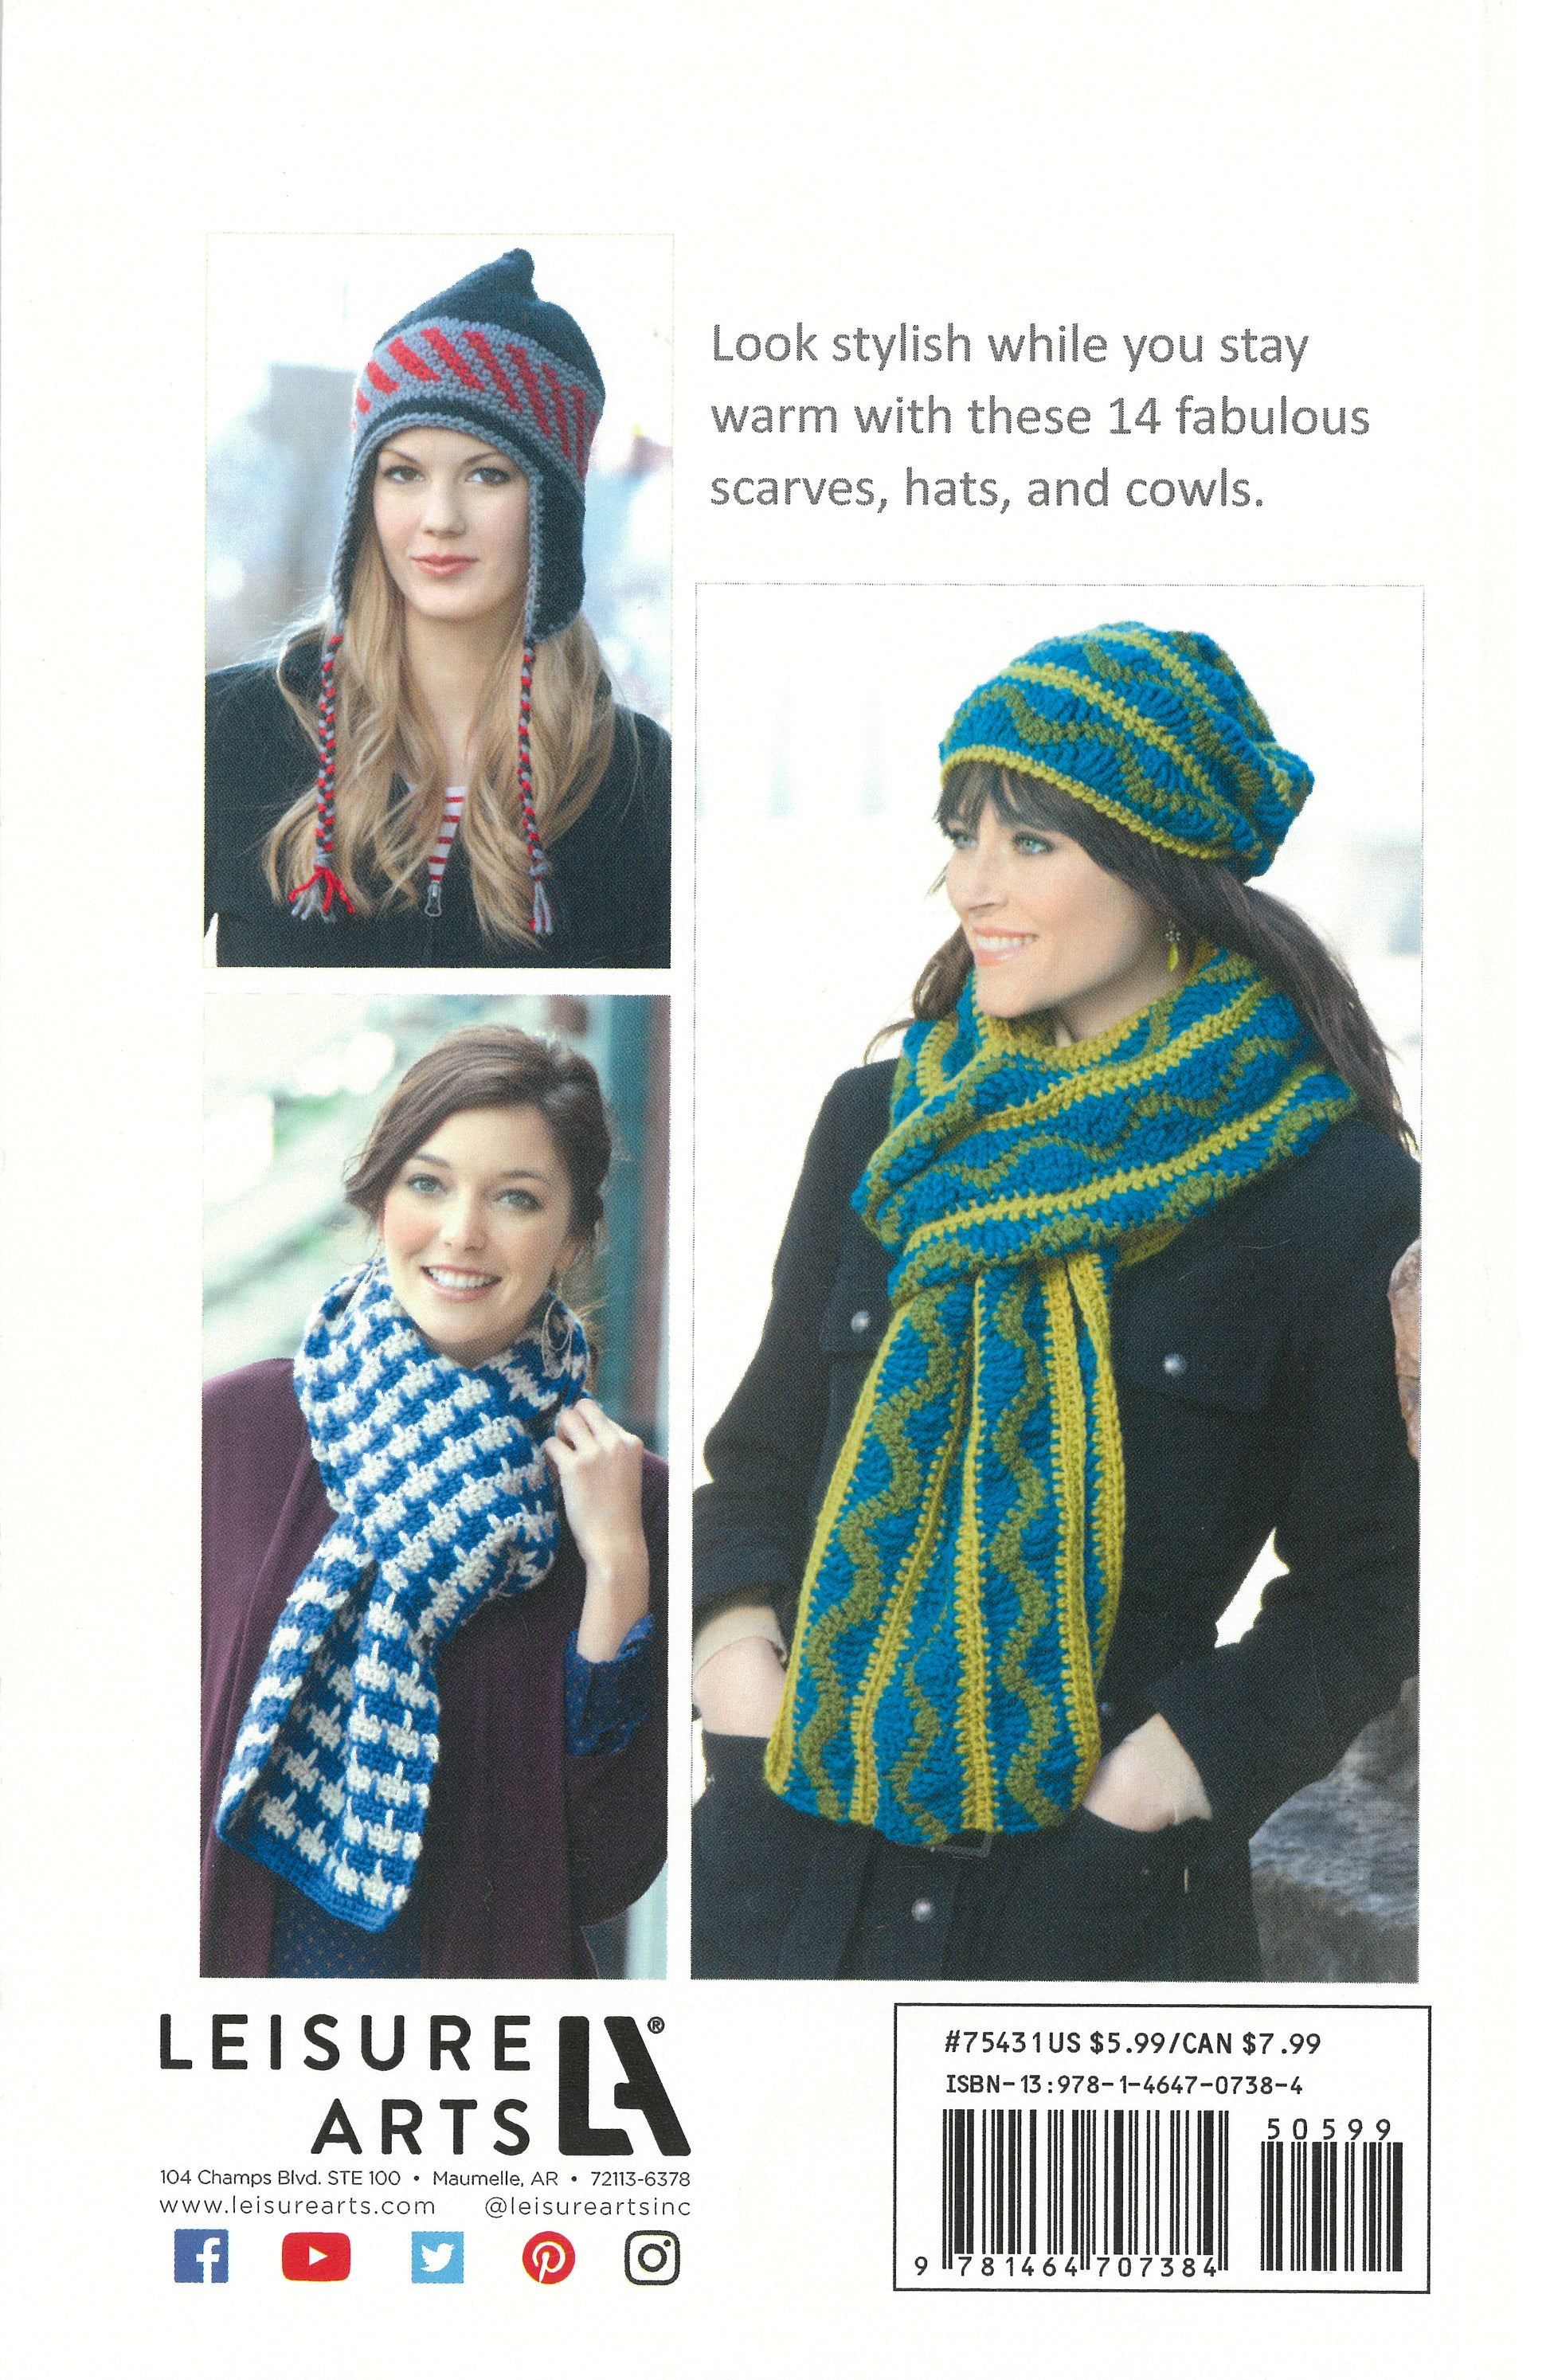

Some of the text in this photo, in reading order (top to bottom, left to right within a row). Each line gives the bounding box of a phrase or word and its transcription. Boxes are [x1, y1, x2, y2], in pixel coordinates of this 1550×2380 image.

[714, 322, 1309, 373] Look stylish while you stay
[710, 394, 1370, 436] warm with these 14 fabulous
[710, 466, 1263, 515] scarves, hats, and cowls.
[159, 2013, 530, 2072] LEISURE
[1090, 2030, 1232, 2055] $5.99/CAN
[1243, 2031, 1321, 2056] $7.99
[310, 2098, 530, 2156] ARTS
[1267, 2118, 1391, 2140] 50599
[160, 2169, 691, 2188] 104 Champs Blvd. STE 100 Maumelle, AR 72113-6378
[159, 2195, 691, 2219] www.leisurearts.com @leisureartsinc
